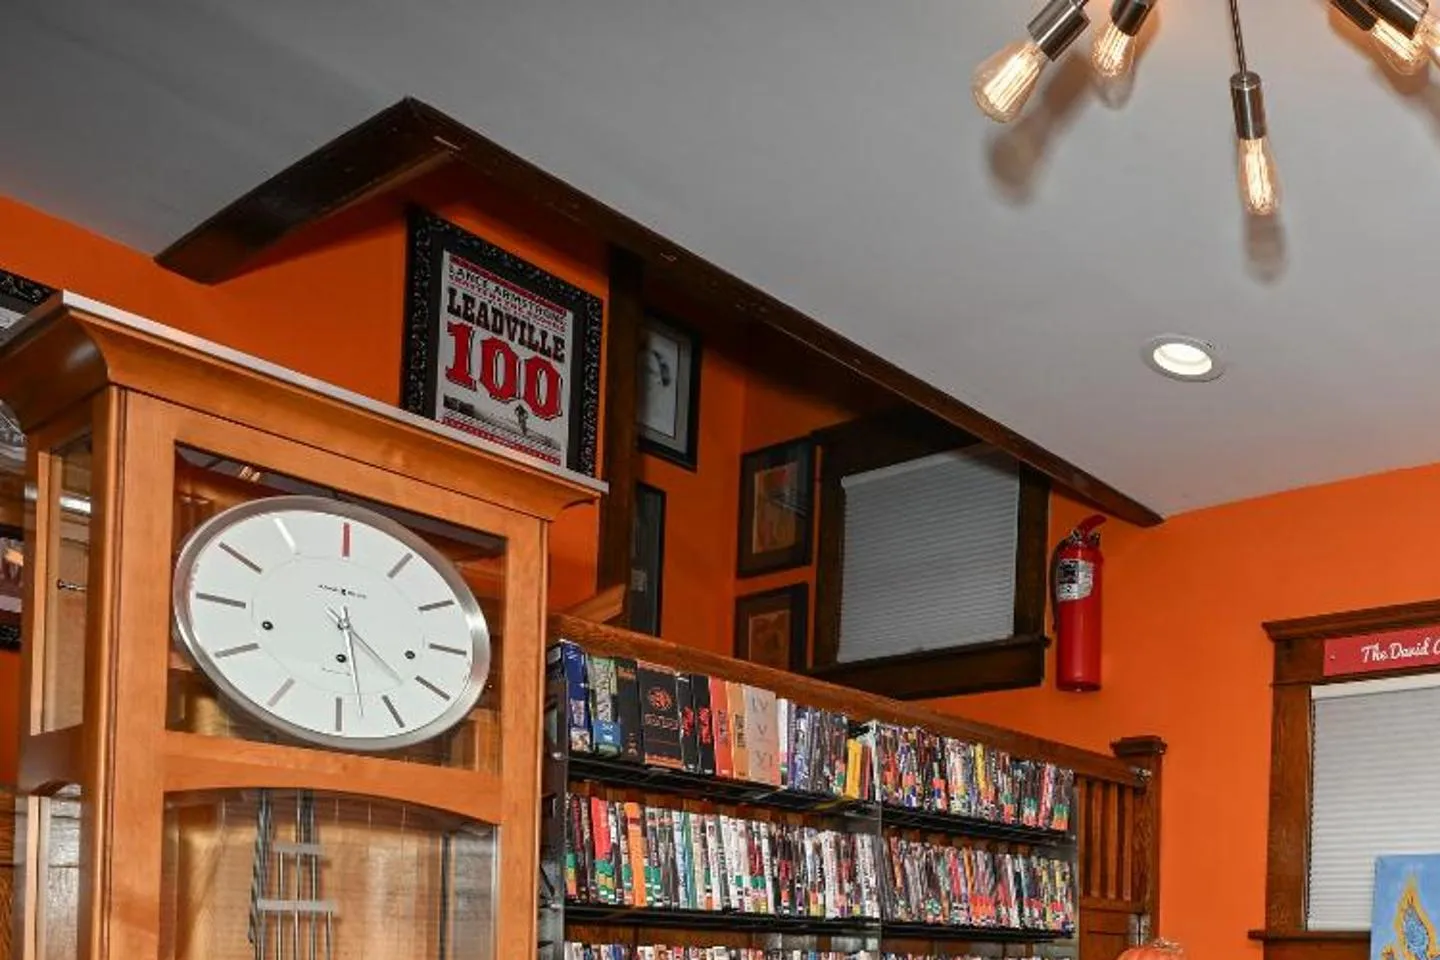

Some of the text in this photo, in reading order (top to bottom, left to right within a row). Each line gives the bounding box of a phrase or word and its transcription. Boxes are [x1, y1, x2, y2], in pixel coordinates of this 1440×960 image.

[446, 287, 566, 363] LEADVILLE
[445, 322, 564, 421] 100
[1361, 643, 1388, 663] The
[1390, 637, 1430, 660] David
